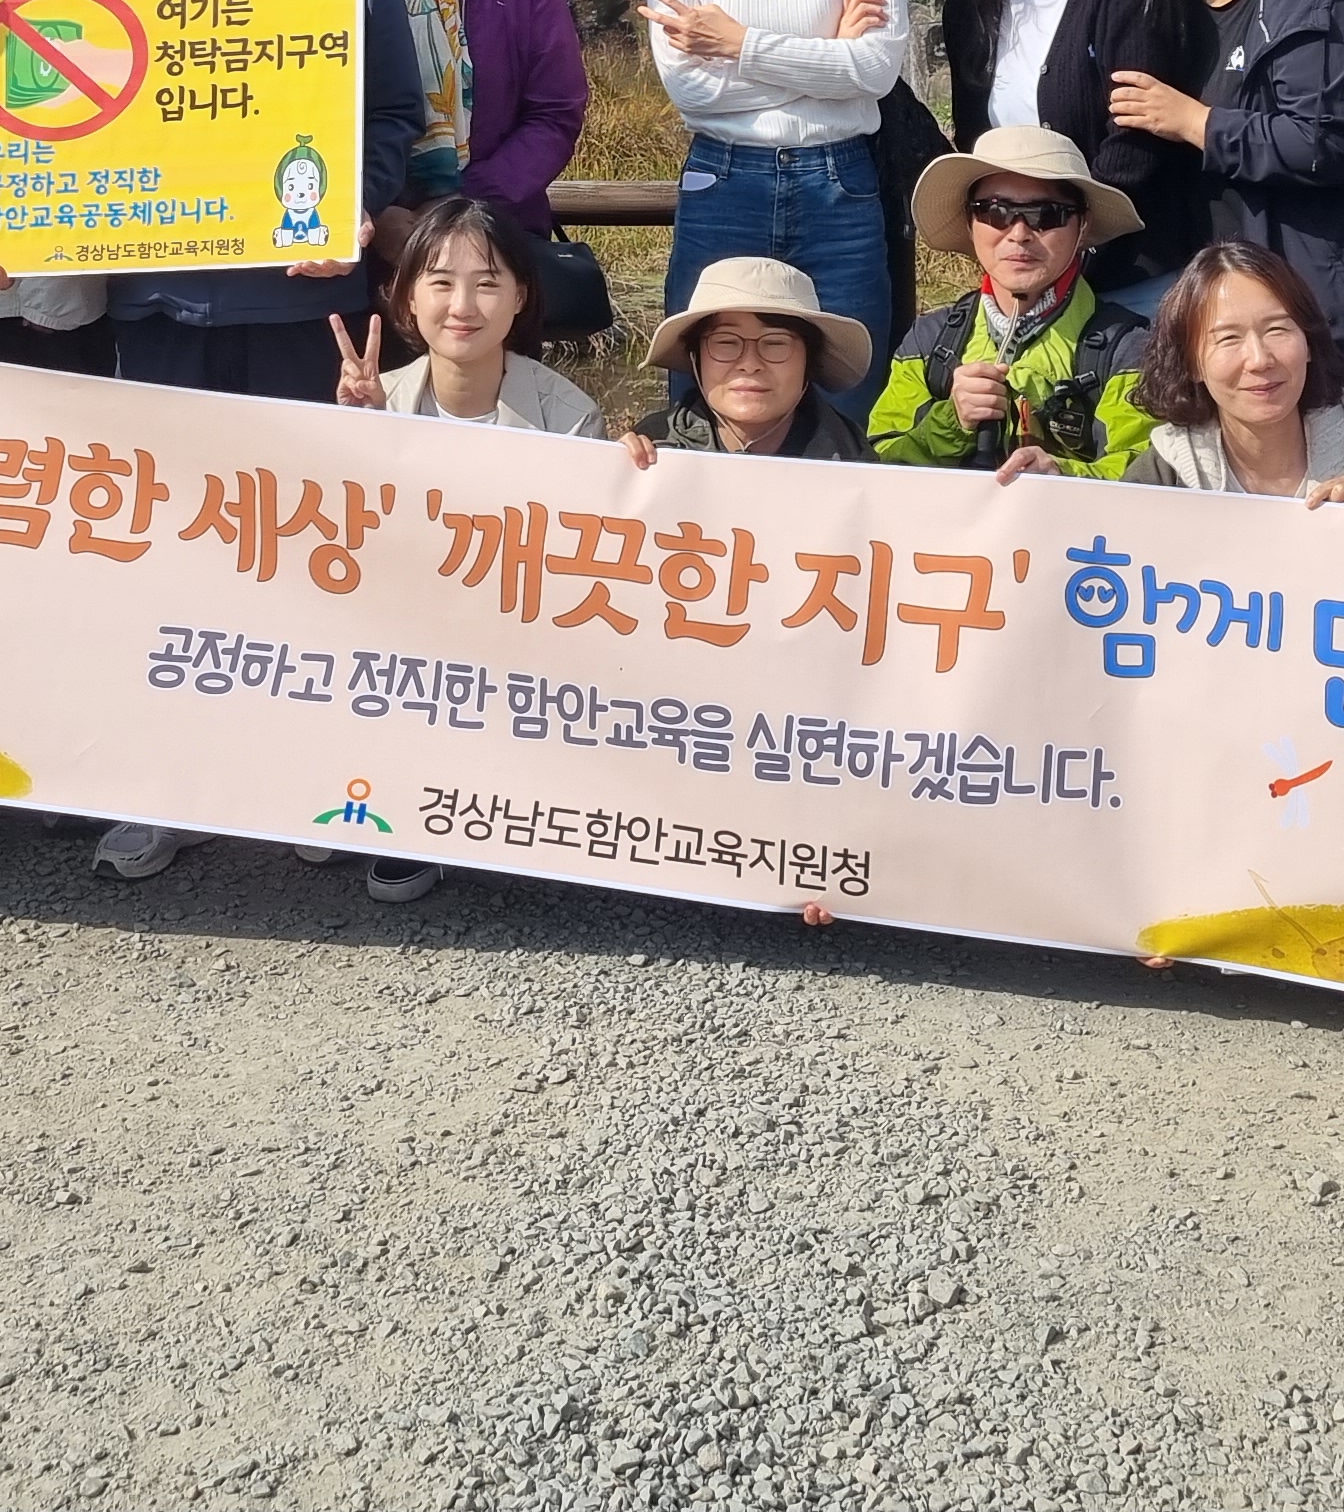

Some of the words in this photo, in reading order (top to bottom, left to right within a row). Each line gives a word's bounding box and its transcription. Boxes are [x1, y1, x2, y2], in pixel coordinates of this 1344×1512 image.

[155, 31, 348, 76] 청탁금지구역
[156, 83, 259, 122] 입니다.
[86, 168, 162, 194] 정직한
[76, 238, 244, 262] 경상남도함안교육지원청
[179, 468, 396, 594] 세상'
[428, 489, 768, 646] '깨끗한
[782, 539, 1030, 673] 지구'
[1068, 538, 1282, 676] 함께
[149, 627, 334, 701] 공정하고
[348, 652, 497, 729] 정직한
[507, 673, 733, 772] 함안교육을
[747, 714, 1120, 807] 실현하겠습니다.
[419, 787, 870, 896] 경상남도함안교육지원청
